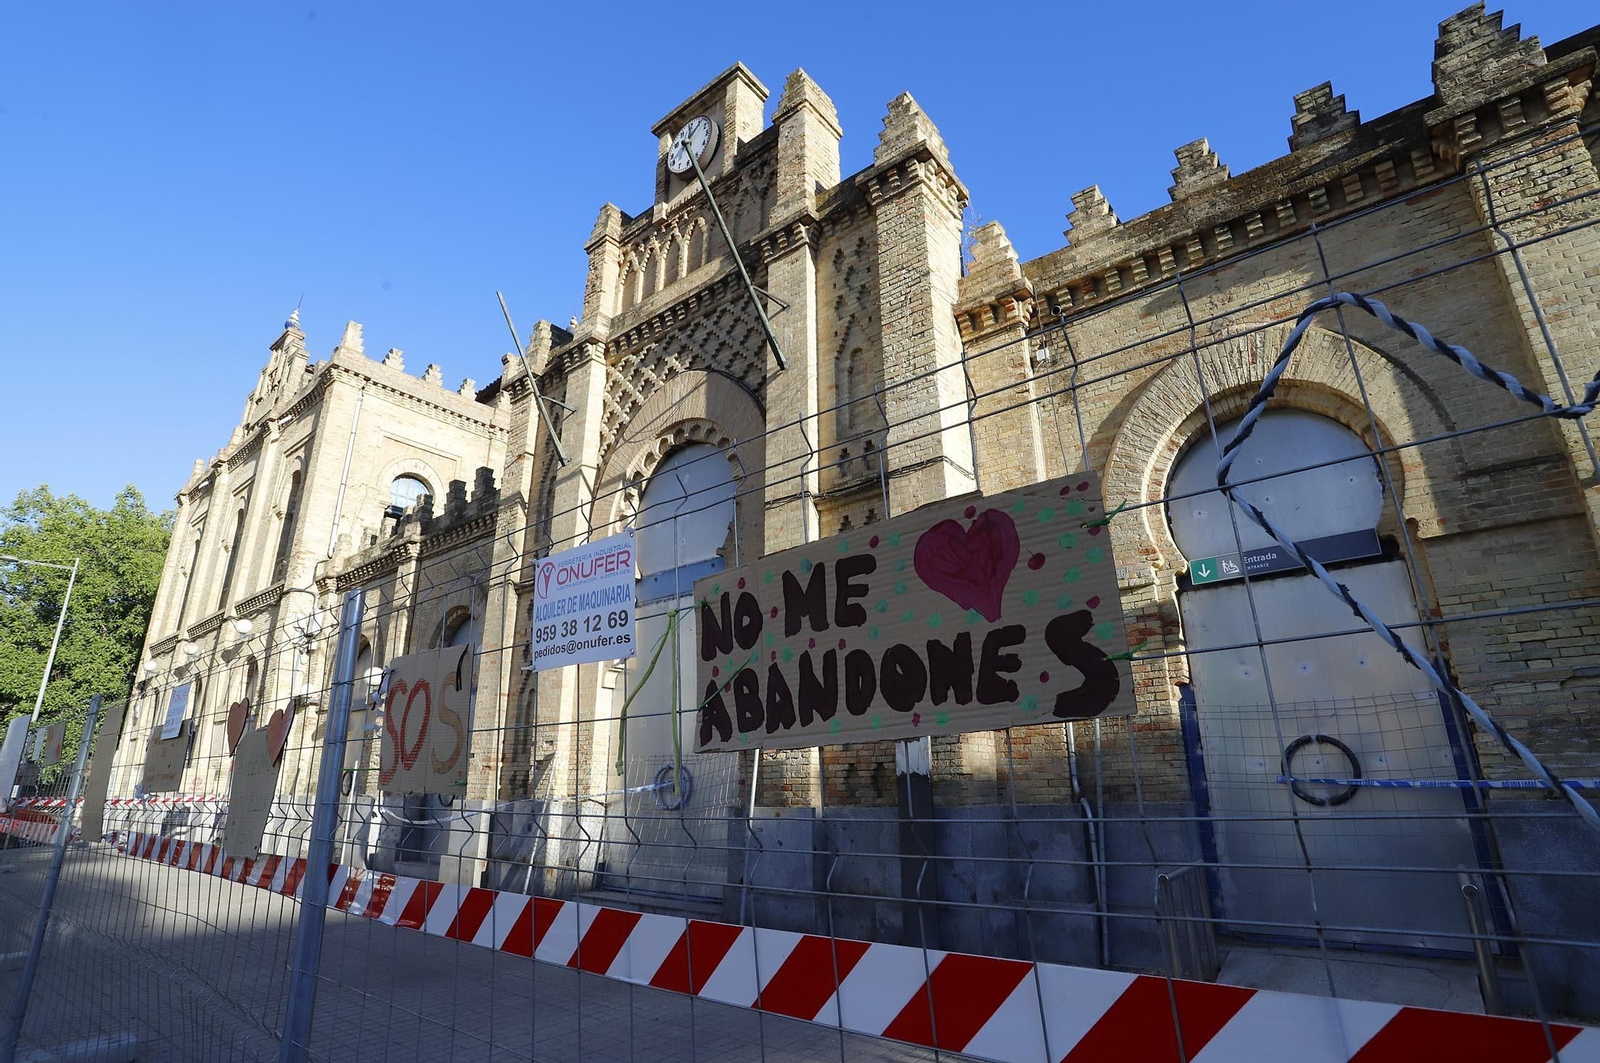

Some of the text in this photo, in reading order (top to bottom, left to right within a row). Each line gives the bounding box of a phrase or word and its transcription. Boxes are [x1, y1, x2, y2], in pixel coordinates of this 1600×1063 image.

[556, 549, 631, 586] ONUFER
[593, 542, 632, 558] INDUSTRIAL
[1243, 552, 1277, 564] Entrada
[534, 583, 631, 623] ALQUILER DE MAQUINARIA
[701, 553, 877, 662] NO ME
[535, 609, 629, 645] 959 38 12 69
[534, 633, 631, 661] pedidos@onufer.es
[379, 672, 464, 786] SOS
